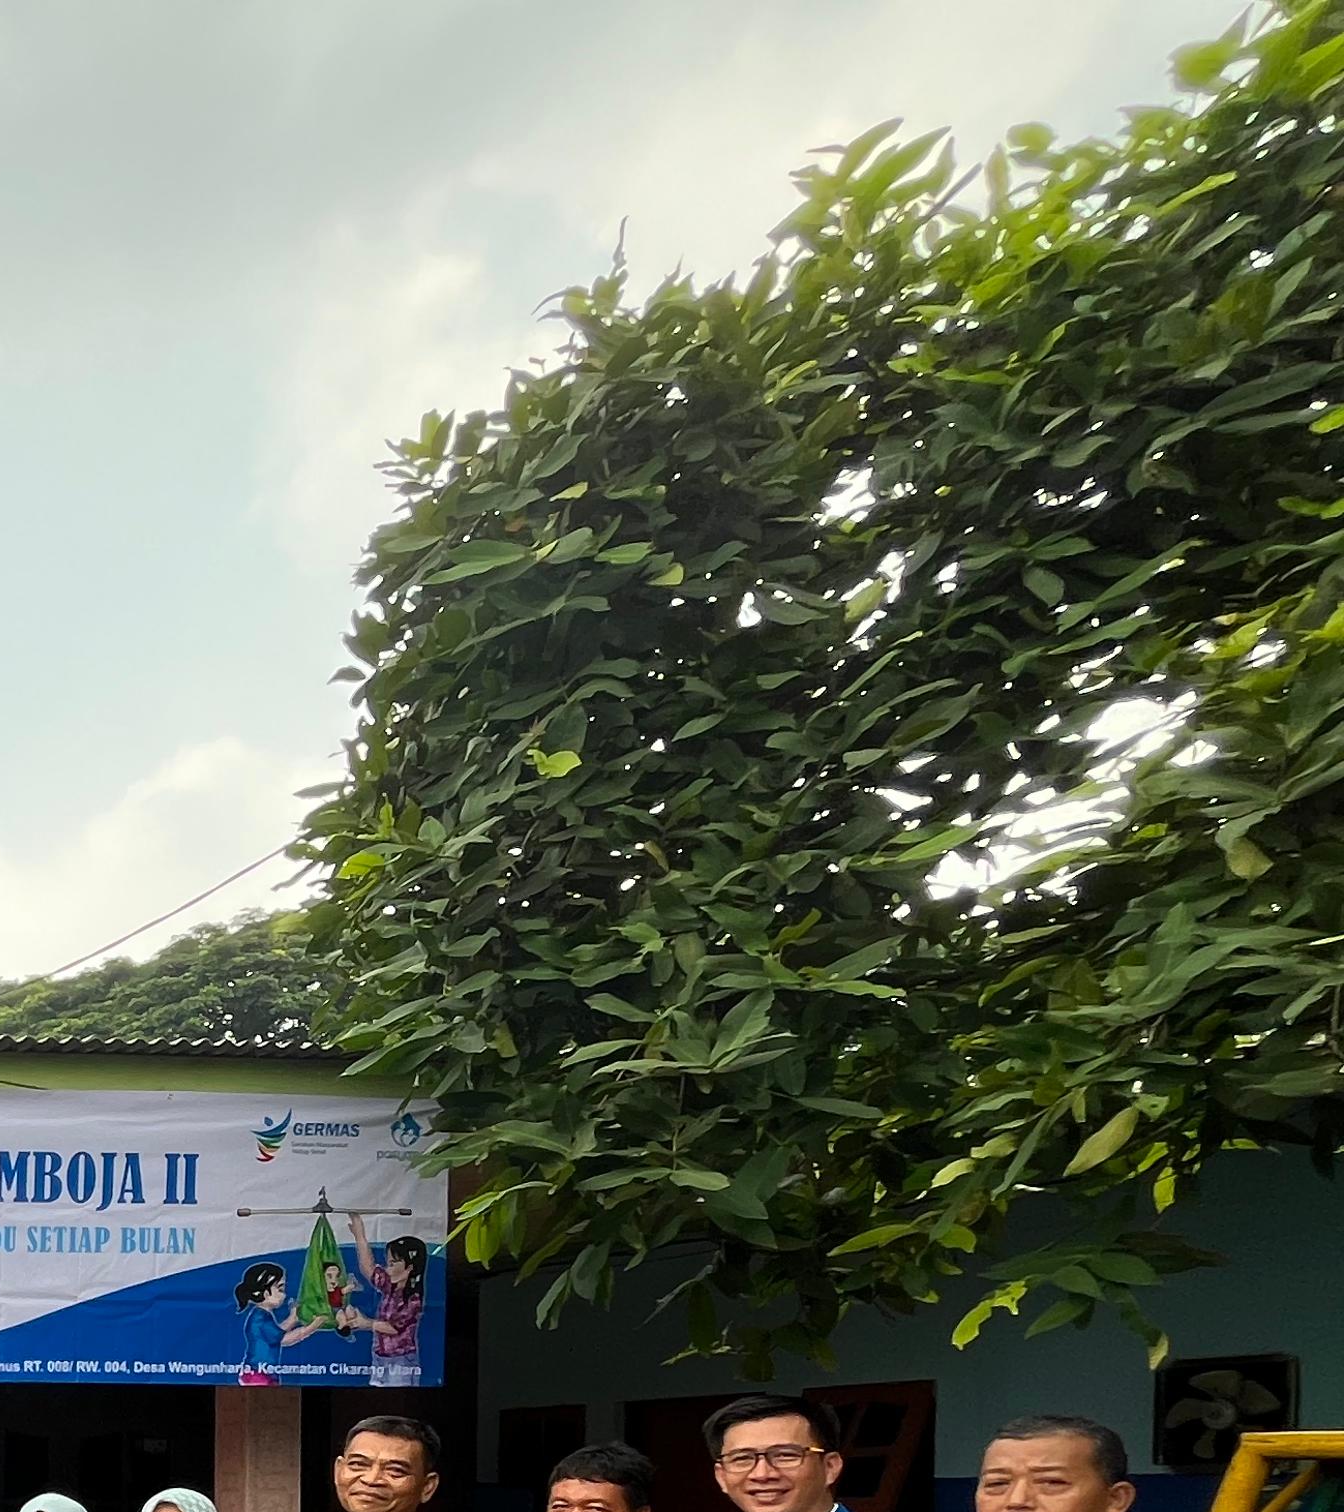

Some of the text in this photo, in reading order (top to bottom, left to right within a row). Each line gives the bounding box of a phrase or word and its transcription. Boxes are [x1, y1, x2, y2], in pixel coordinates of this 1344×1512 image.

[292, 1122, 361, 1138] GERMAS
[163, 1152, 200, 1206] II
[27, 1225, 111, 1254] SETIAP
[120, 1226, 197, 1254] BULAN
[23, 1360, 44, 1373] RT.
[76, 1361, 102, 1373] RW.
[104, 1361, 131, 1374] 004,
[134, 1361, 166, 1373] Desa
[258, 1362, 326, 1375] Kecamatan
[329, 1362, 385, 1377] Cikarang
